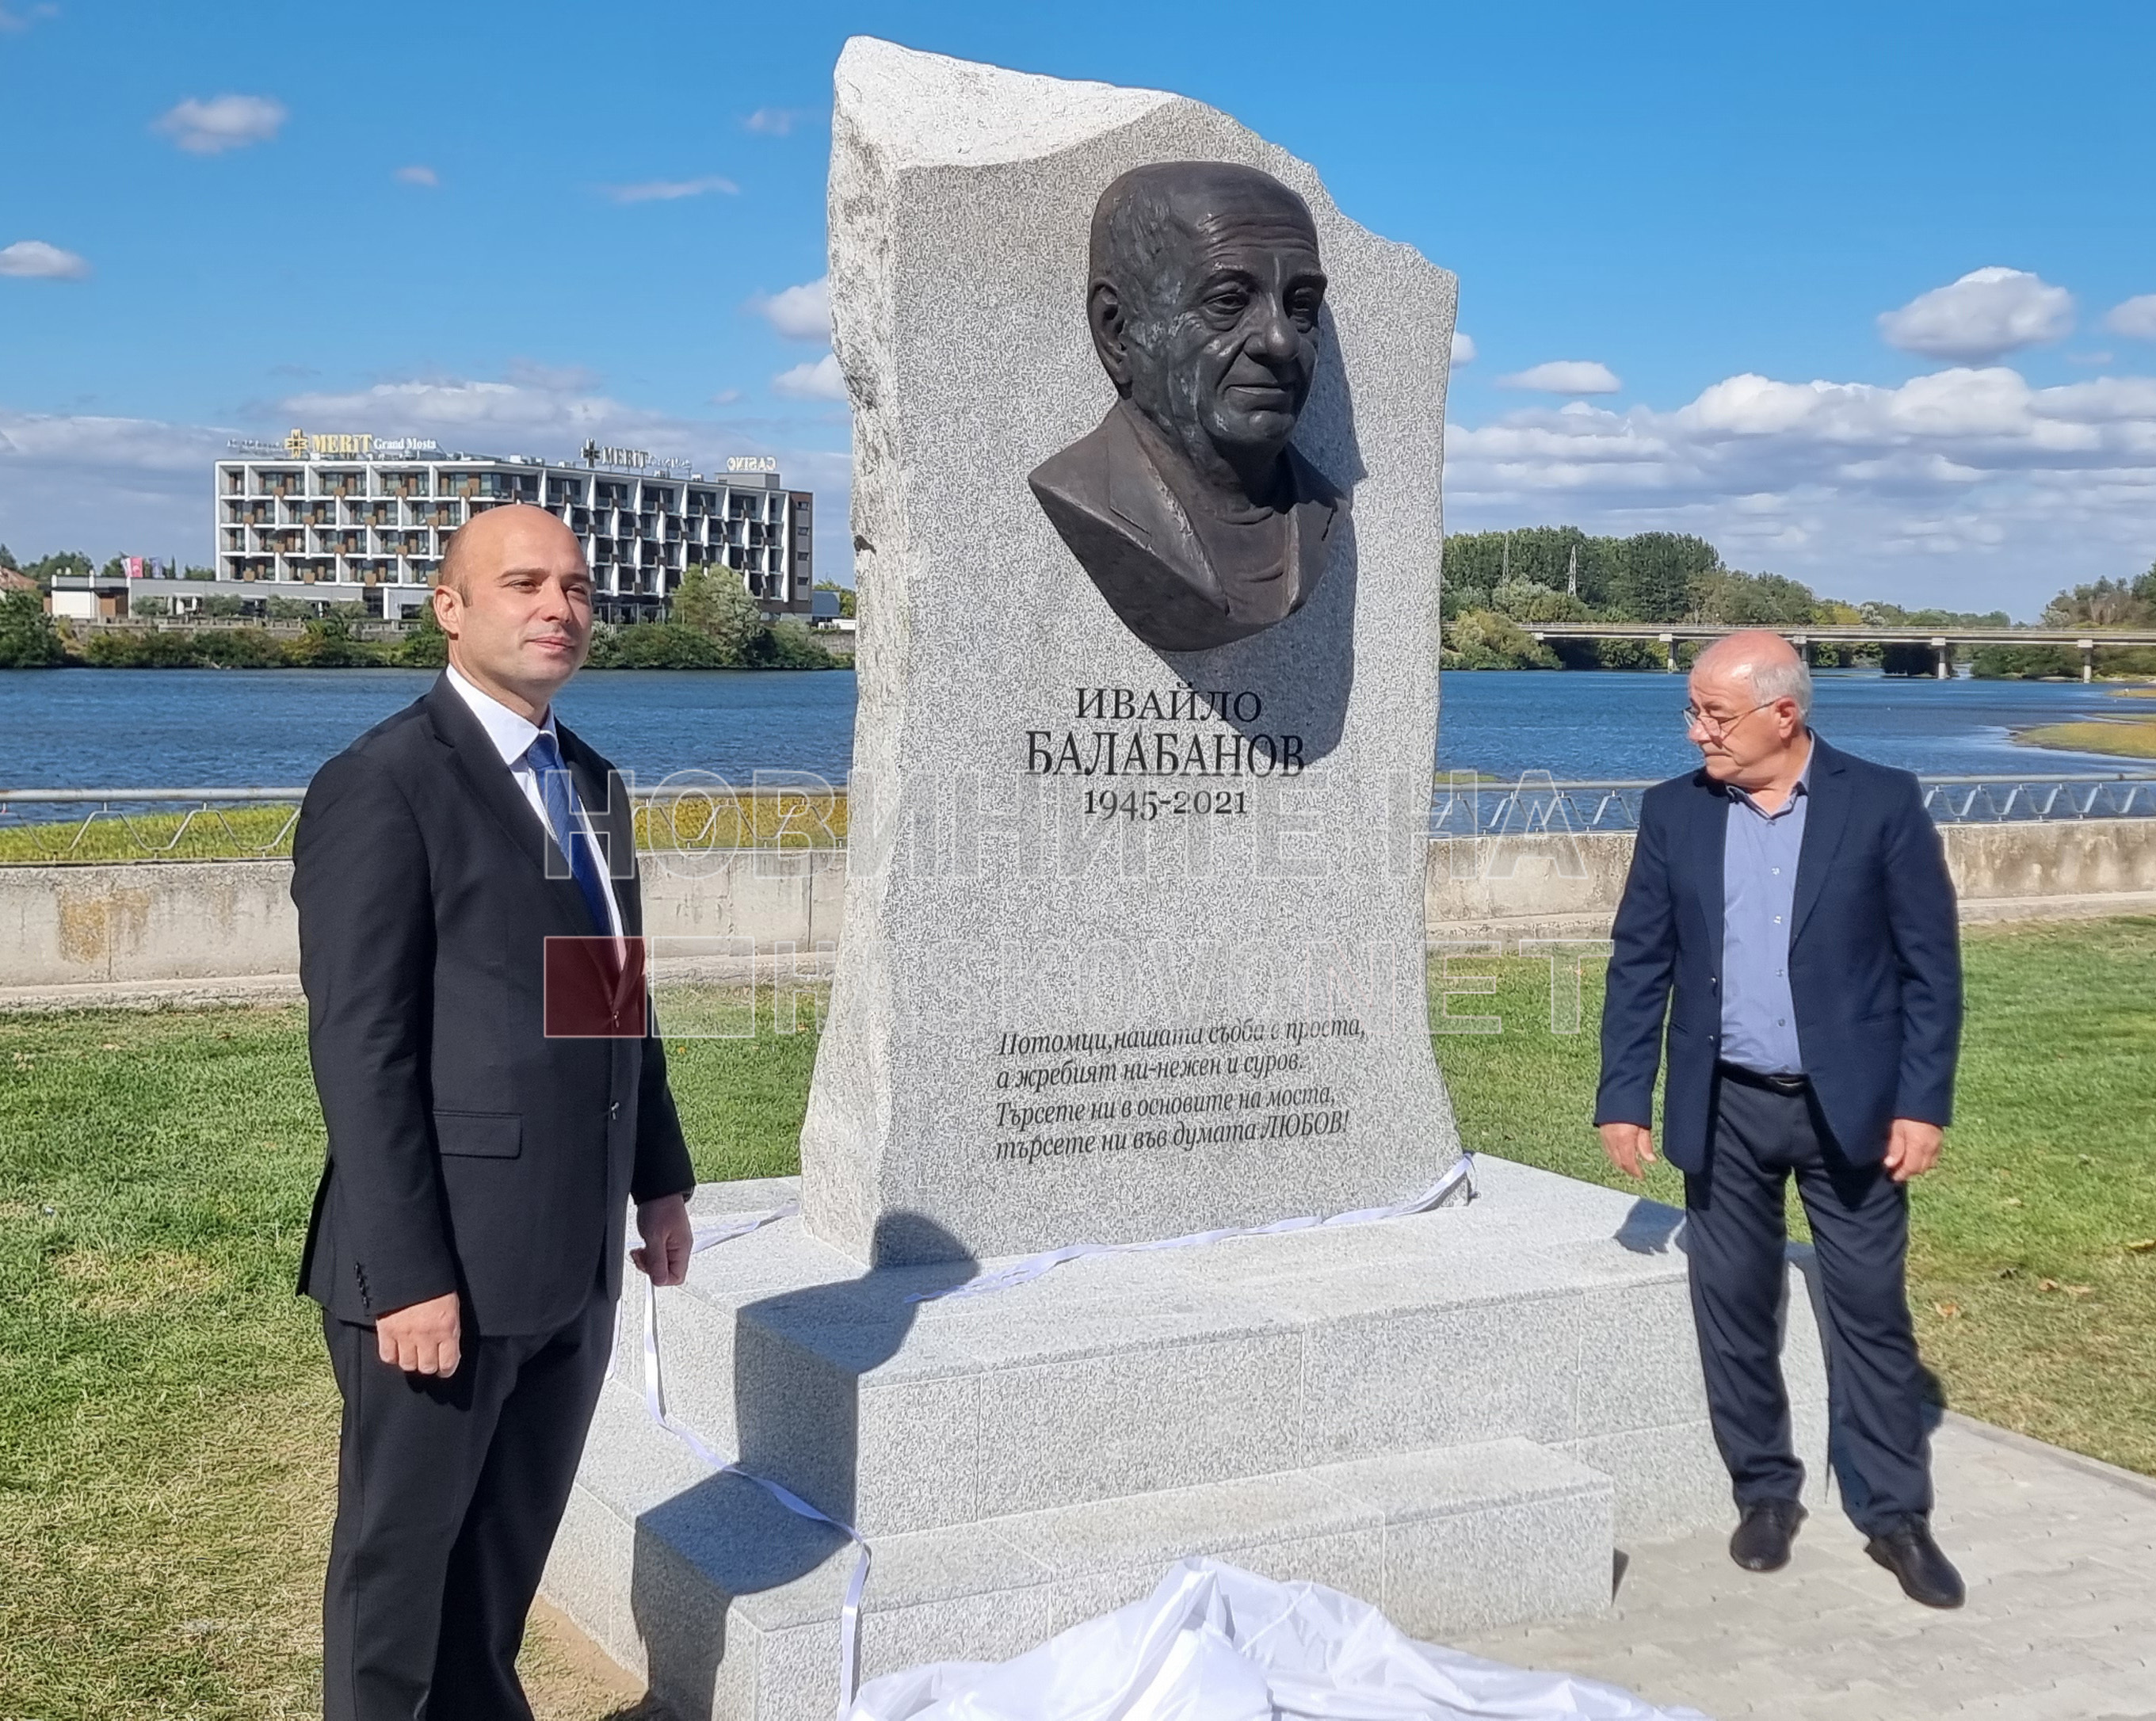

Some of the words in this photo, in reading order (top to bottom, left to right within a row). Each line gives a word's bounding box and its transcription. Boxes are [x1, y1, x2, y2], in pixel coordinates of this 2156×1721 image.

[373, 437, 403, 450] Grand
[1075, 681, 1263, 723] ИВАЙЛО
[1026, 730, 1305, 777] БАЛАБАНОВ
[1083, 790, 1248, 822] 1945-2021
[996, 1070, 1010, 1089] а
[1014, 1059, 1117, 1093] жребият
[1227, 1055, 1238, 1074] и
[996, 1102, 1086, 1132] Търсете
[1090, 1101, 1116, 1121] ни
[1121, 1099, 1132, 1119] в
[1136, 1092, 1234, 1119] основите
[1238, 1090, 1262, 1109] на
[996, 1135, 1097, 1165] търсете
[1101, 1132, 1128, 1152] ни
[1133, 1128, 1168, 1150] във
[1173, 1120, 1257, 1151] думата
[1261, 1110, 1350, 1139] ЛЮБОВ!
